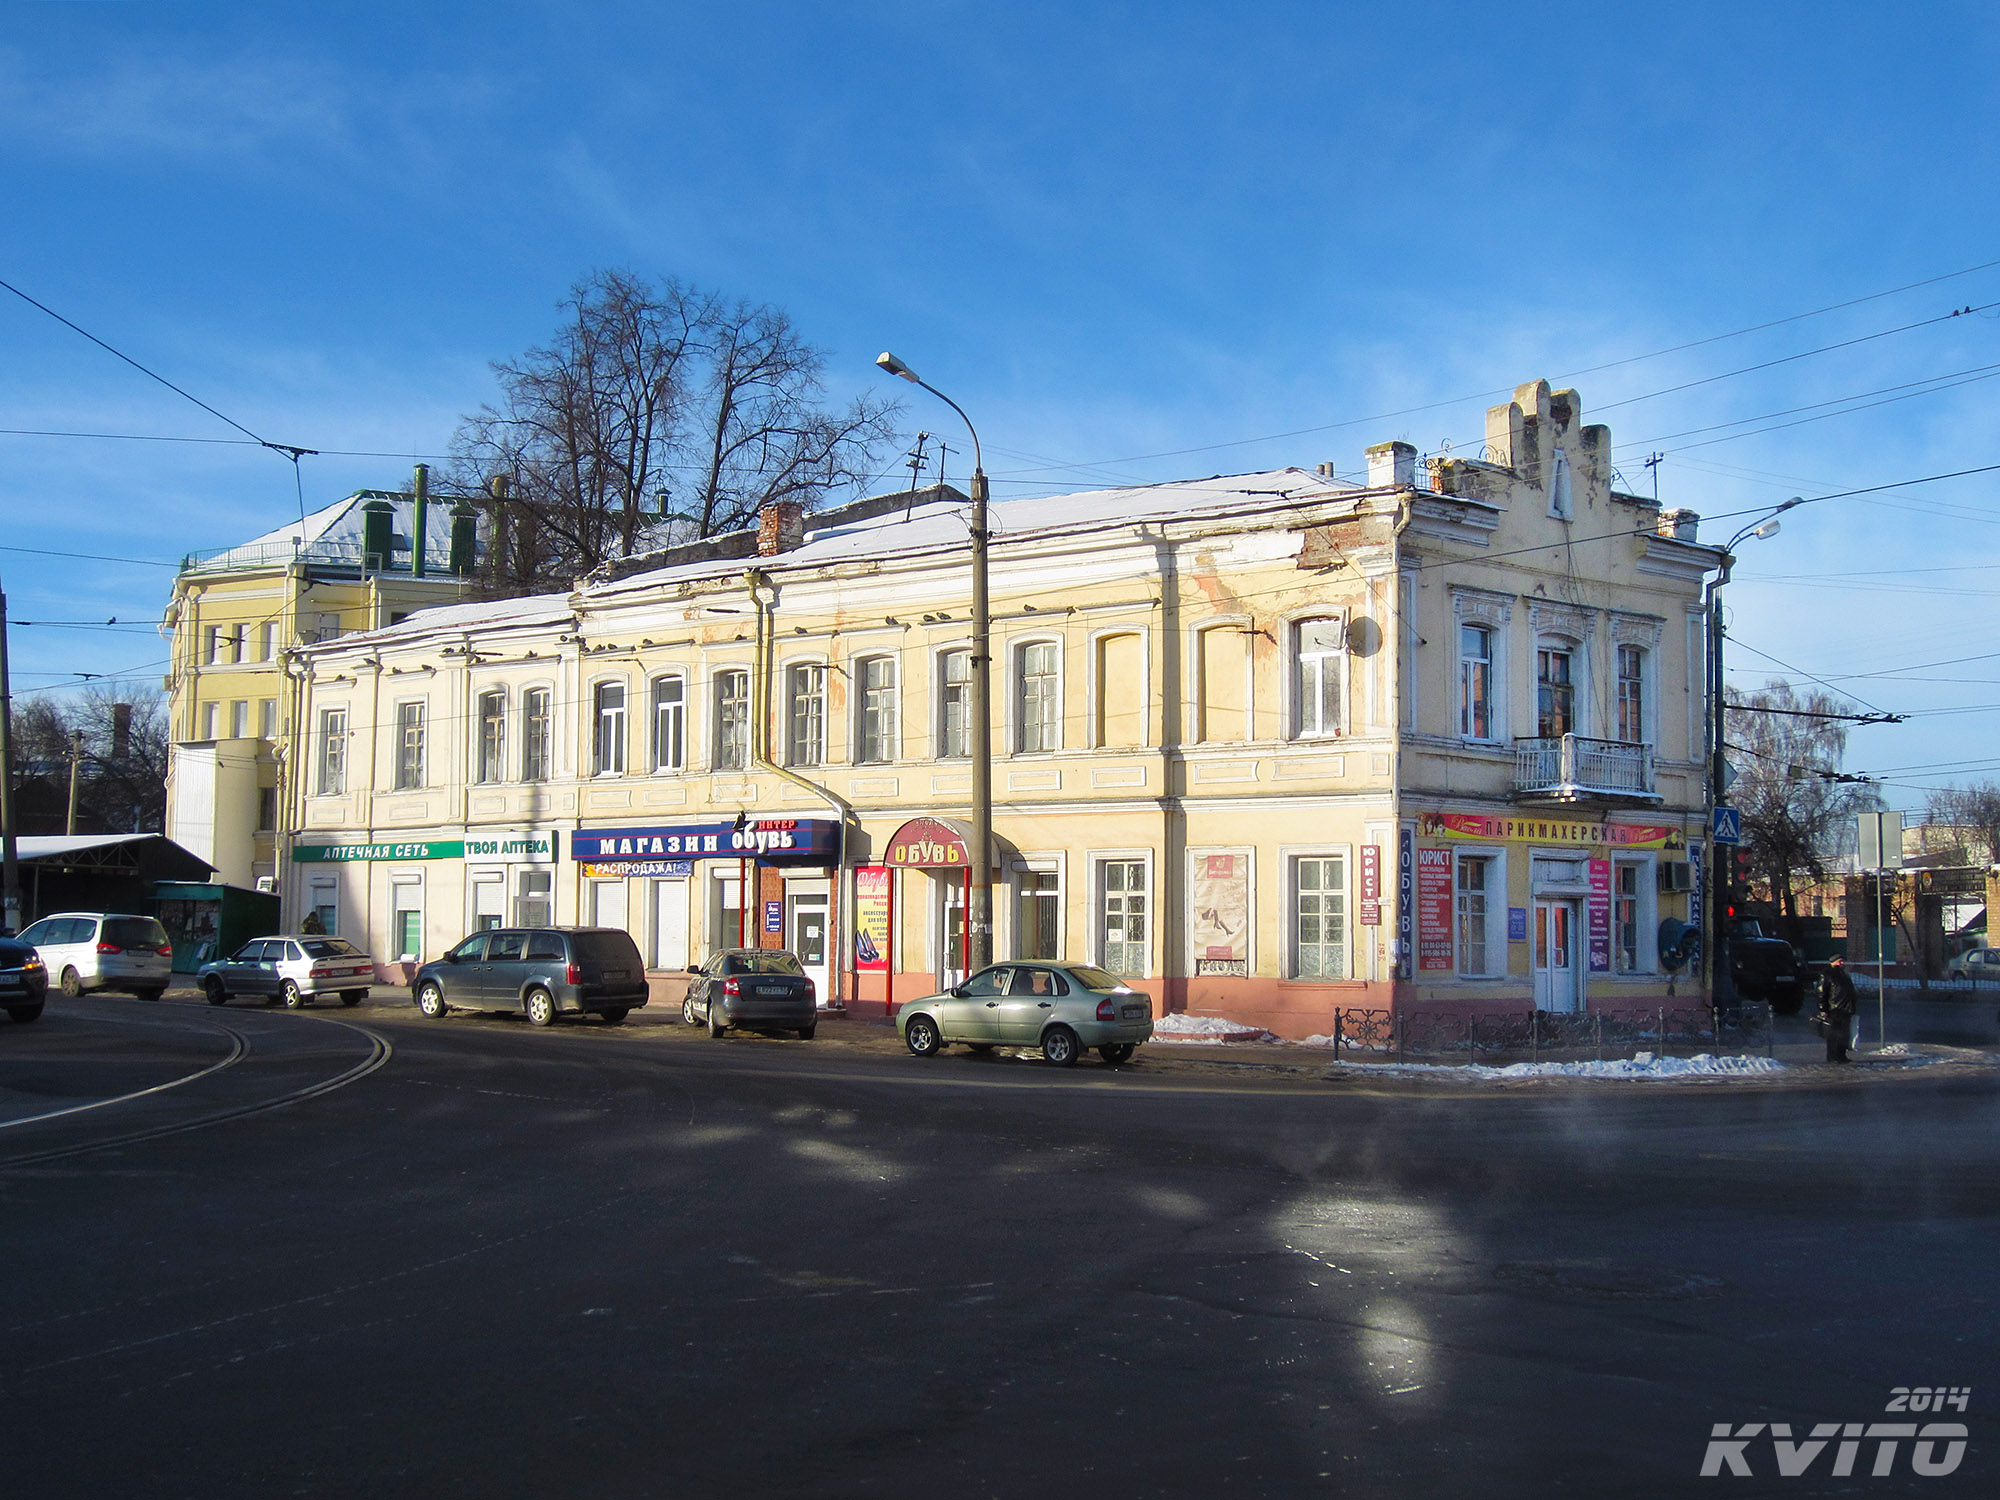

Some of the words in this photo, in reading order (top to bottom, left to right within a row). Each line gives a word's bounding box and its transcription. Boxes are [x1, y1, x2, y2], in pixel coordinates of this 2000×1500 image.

[1485, 820, 1627, 843] ПАРИКМАХЕРСКАЯ
[323, 846, 390, 860] АПТЕЧНАЯ
[395, 844, 429, 857] СЕТЬ
[466, 841, 498, 855] ТВОЯ
[501, 839, 549, 854] АПТЕКА
[600, 835, 718, 855] МАГАЗИН
[895, 840, 960, 864] ОБУВЬ
[1419, 850, 1450, 865] ЮРИСТ
[595, 862, 677, 876] РАСПРОДАЖА!
[1362, 847, 1376, 897] ЮРИСТ
[1401, 850, 1411, 954] ОБУВЬ
